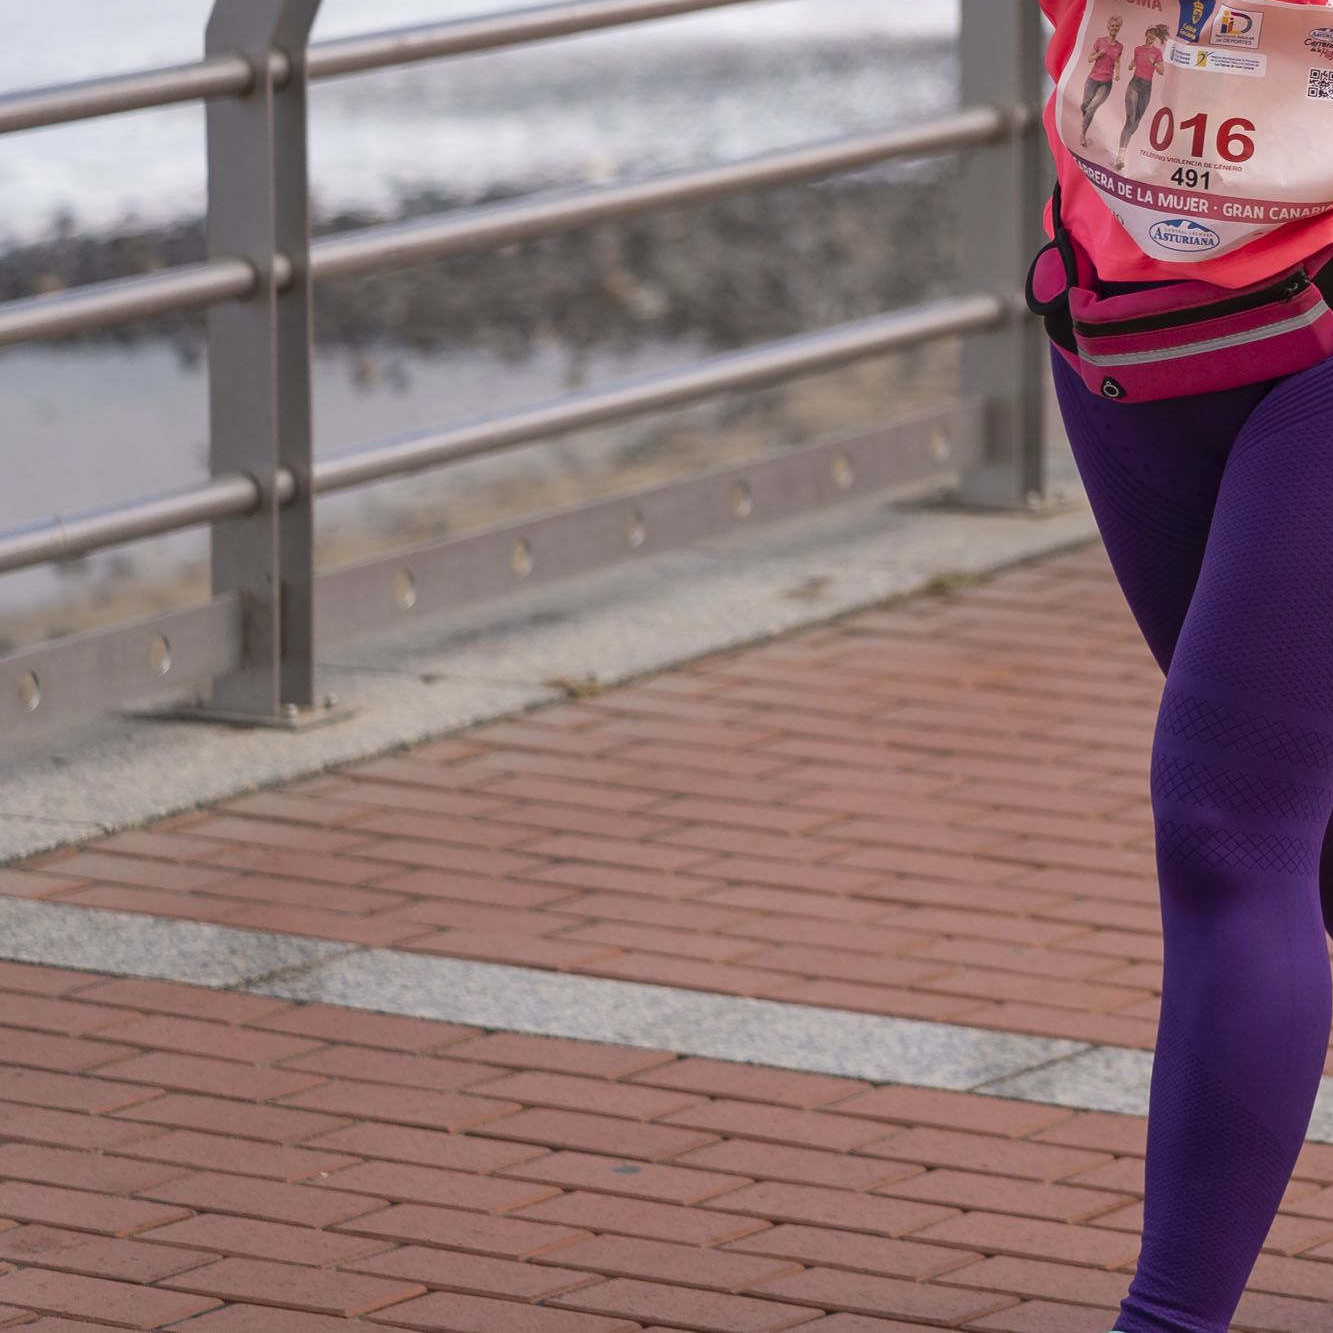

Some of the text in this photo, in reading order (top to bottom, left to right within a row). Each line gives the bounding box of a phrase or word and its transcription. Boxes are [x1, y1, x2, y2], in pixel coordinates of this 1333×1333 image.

[1149, 106, 1257, 163] 016
[1166, 156, 1203, 168] VIOLENCIA
[1170, 167, 1210, 190] 491
[1117, 181, 1133, 199] DE
[1137, 187, 1153, 205] LA
[1158, 192, 1209, 213] MUJER
[1223, 202, 1264, 219] GRAN
[1153, 226, 1215, 247] ASTURIANA
